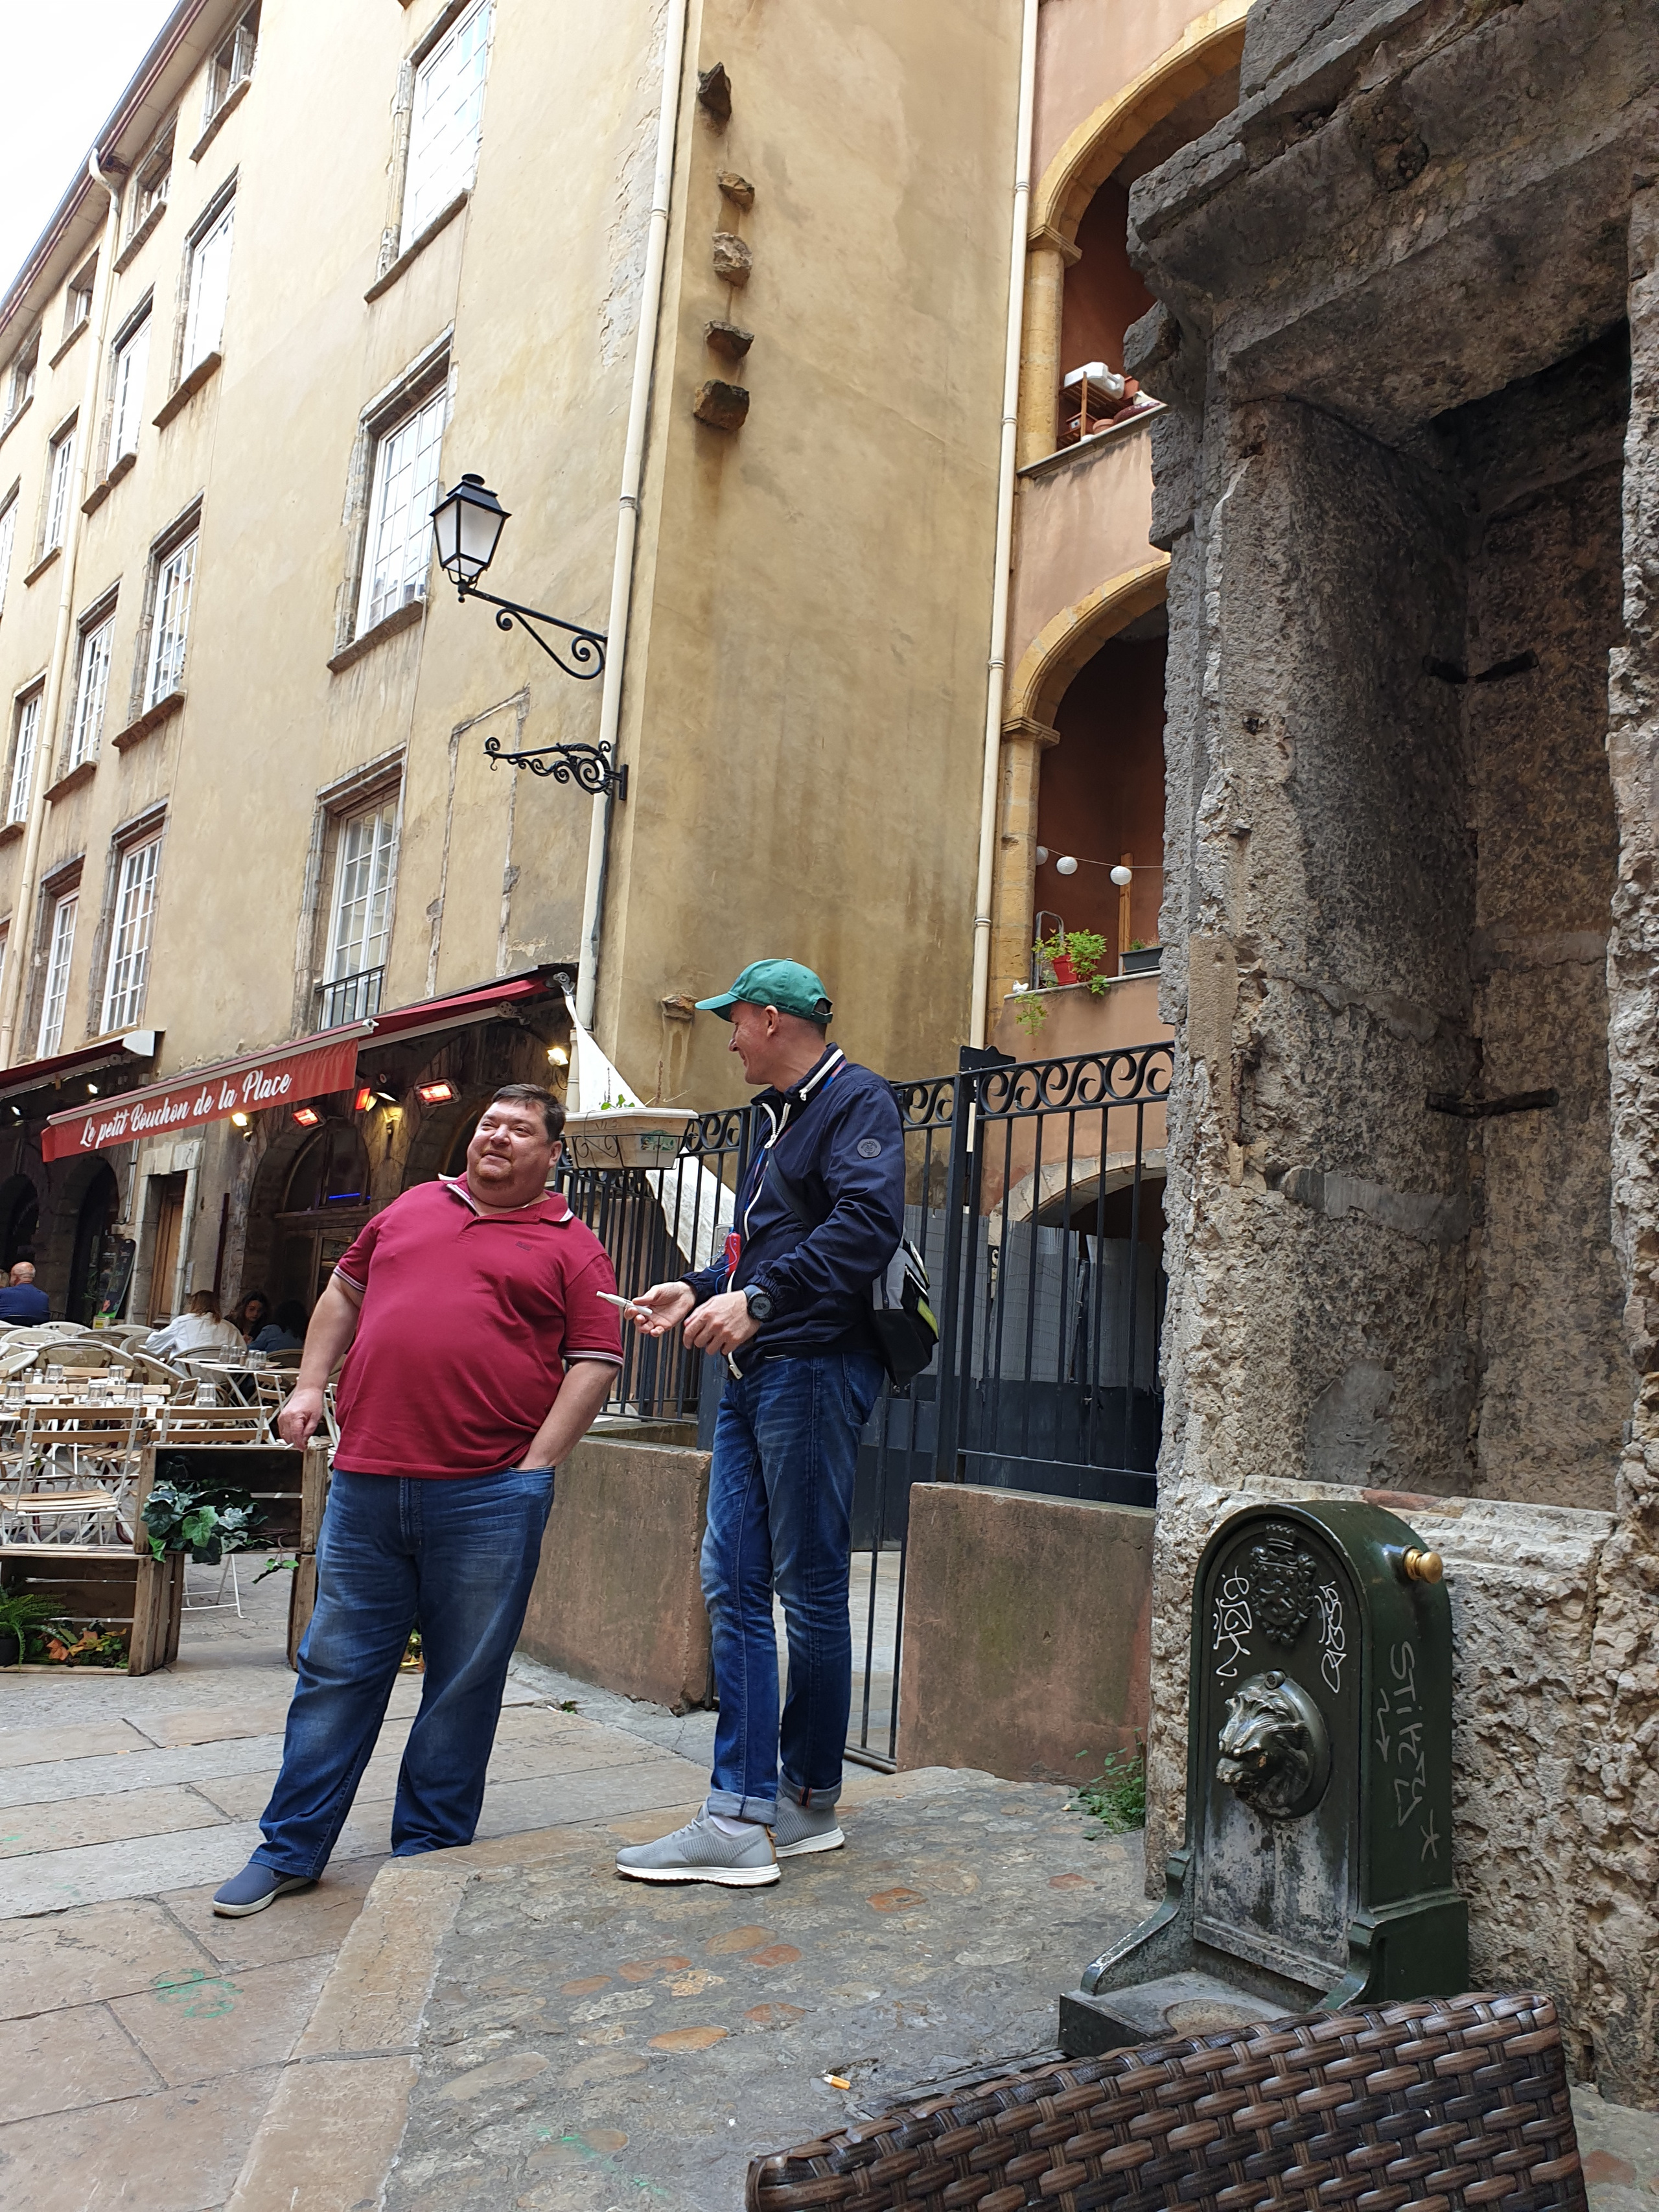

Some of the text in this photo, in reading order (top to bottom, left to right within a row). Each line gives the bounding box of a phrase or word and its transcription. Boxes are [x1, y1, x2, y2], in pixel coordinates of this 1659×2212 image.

[80, 1069, 292, 1149] Le petit Bouchon de la Place
